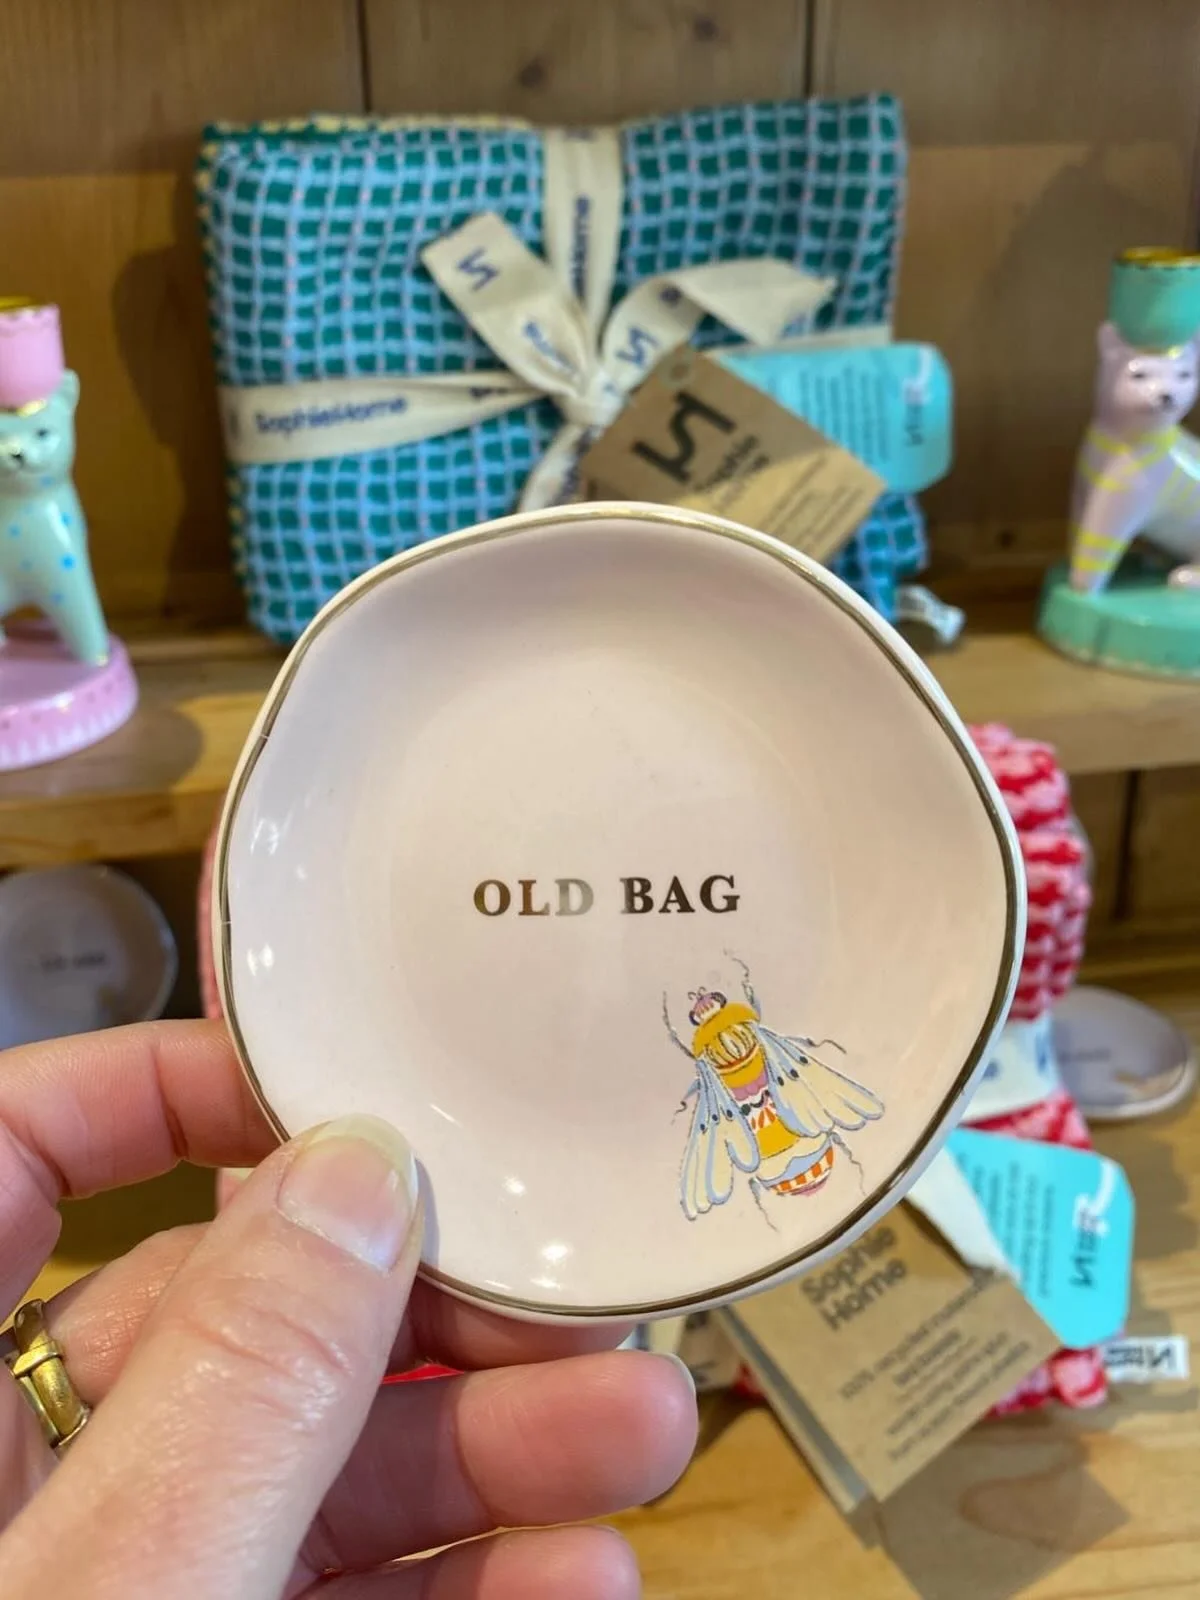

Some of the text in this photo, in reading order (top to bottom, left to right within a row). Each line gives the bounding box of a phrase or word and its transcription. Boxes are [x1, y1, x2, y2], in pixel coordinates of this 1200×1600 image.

[473, 874, 741, 916] OLD BAG
[801, 1226, 896, 1304] Sophie
[820, 1258, 907, 1331] Home
